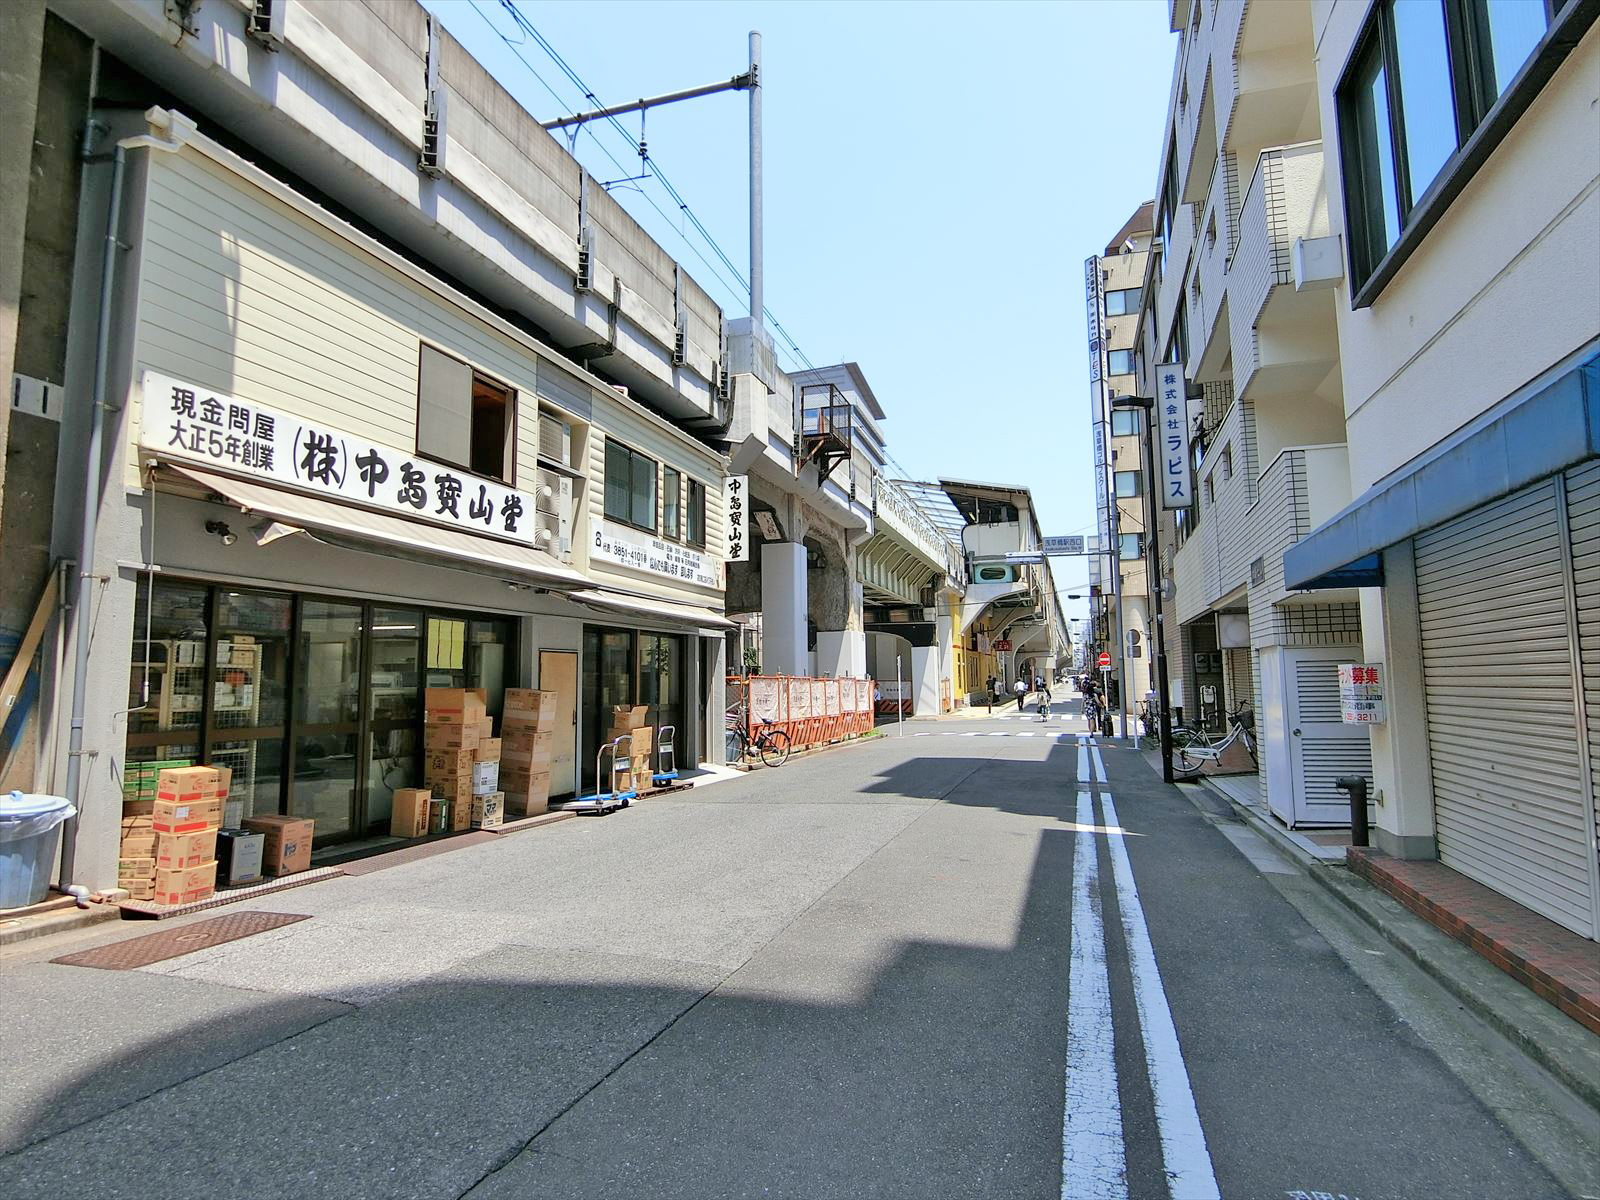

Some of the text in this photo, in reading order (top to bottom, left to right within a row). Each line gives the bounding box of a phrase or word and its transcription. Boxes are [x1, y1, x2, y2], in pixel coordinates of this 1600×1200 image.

[170, 387, 275, 443] 現金問屋
[1163, 374, 1185, 498] 株式会社ラピス
[168, 422, 275, 472] 大正5年創業
[1352, 666, 1379, 685] 募集
